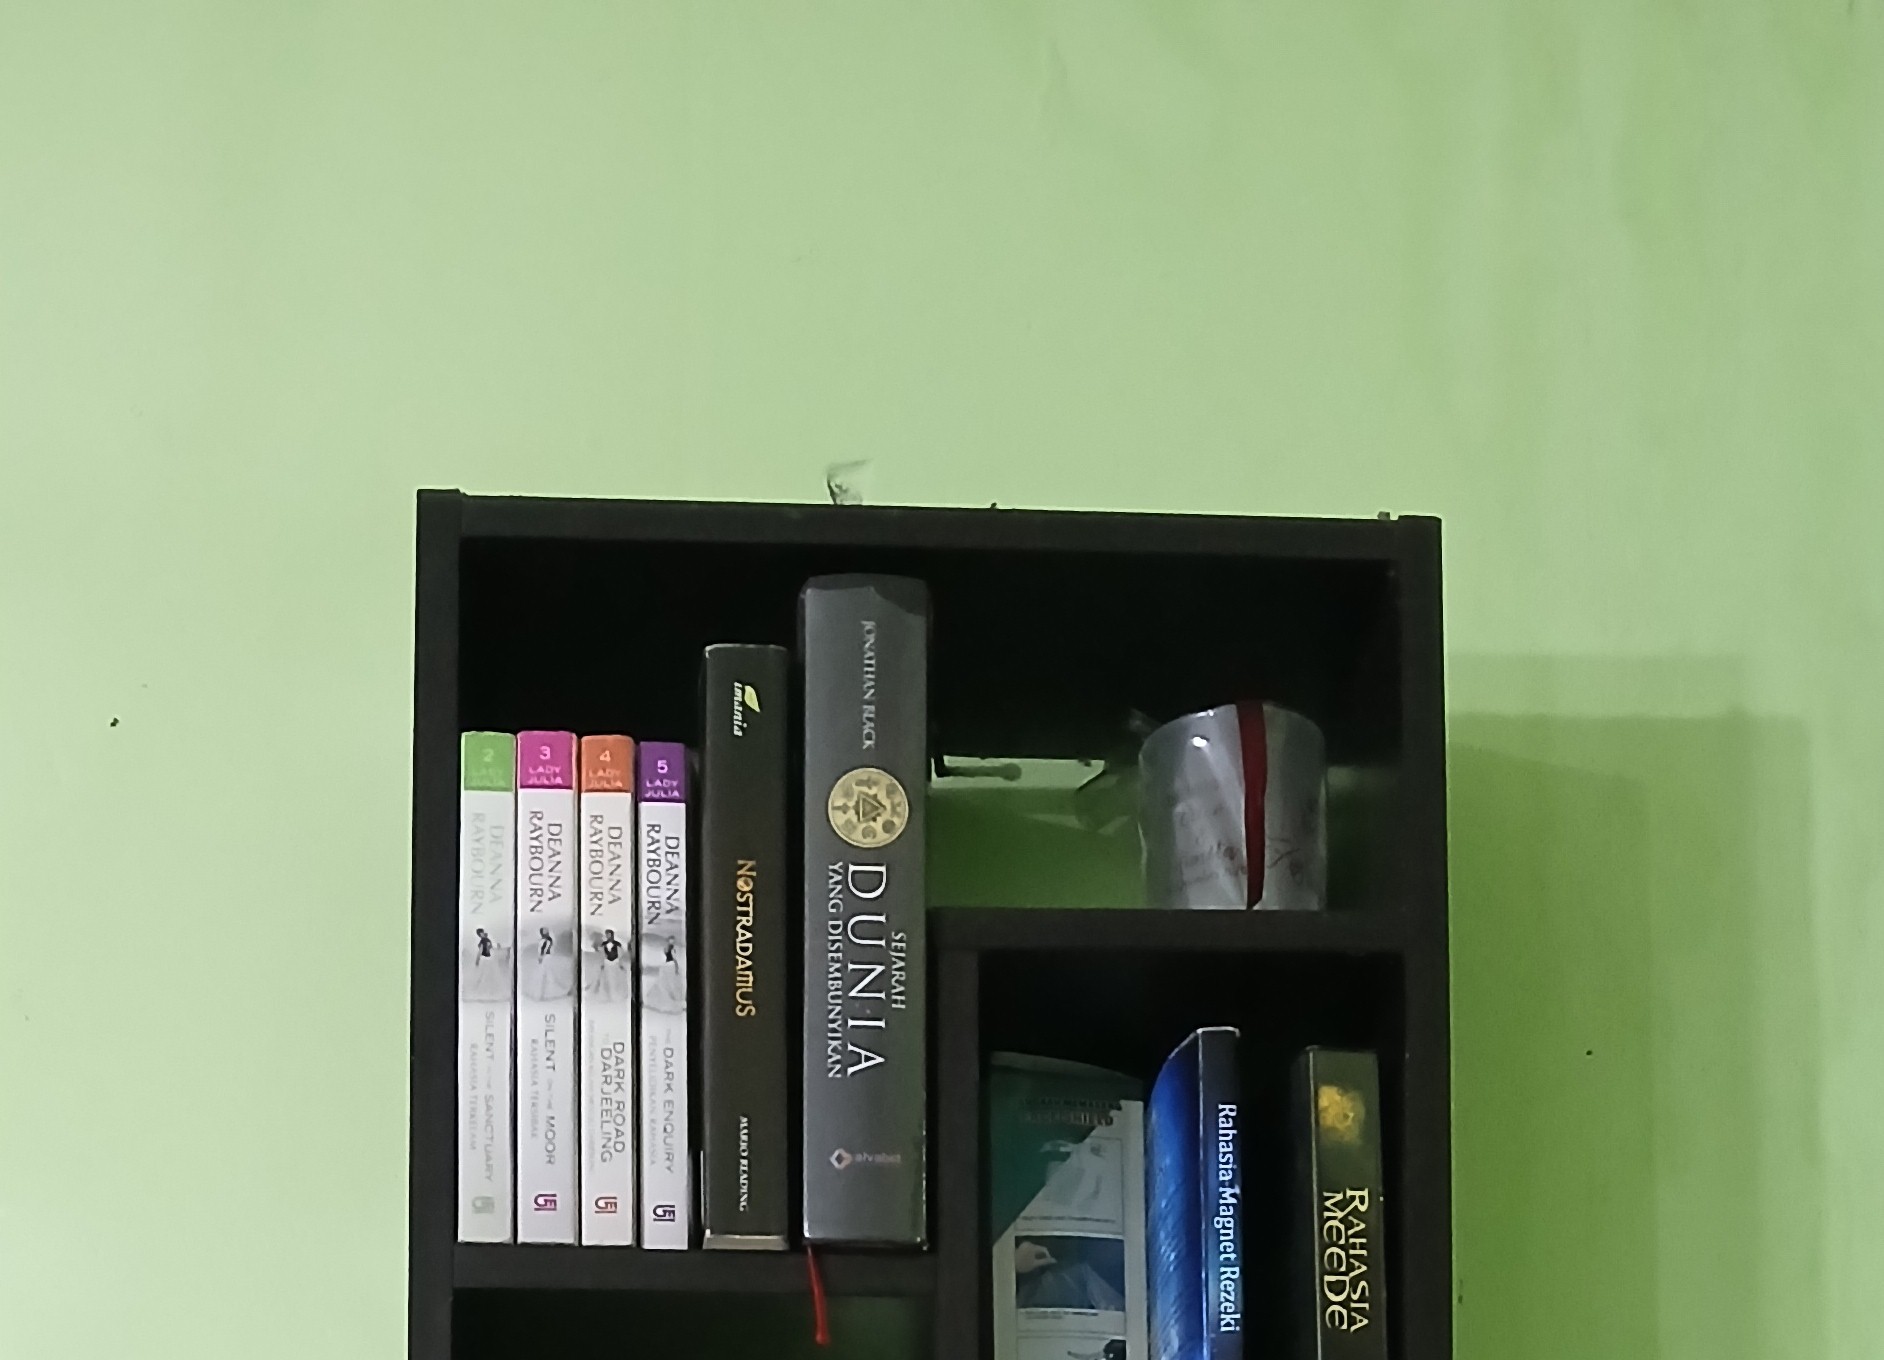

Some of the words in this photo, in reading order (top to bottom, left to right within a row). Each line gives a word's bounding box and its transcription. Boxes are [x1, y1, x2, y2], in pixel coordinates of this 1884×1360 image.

[861, 620, 876, 700] JONATHAN
[483, 749, 494, 762] 2
[539, 746, 551, 760] 3
[600, 750, 611, 762] 4
[862, 704, 876, 750] BLACK
[528, 776, 563, 785] JULIA
[529, 765, 561, 774] LADY
[645, 790, 680, 798] JULIA
[646, 780, 678, 788] LADY
[657, 760, 668, 773] 5
[471, 812, 486, 915] RAYBOURN
[489, 825, 504, 903] DEANNA
[529, 810, 544, 912] RAYBOURN
[547, 823, 562, 901] DEANNA
[589, 815, 604, 916] RAYBOURN
[608, 826, 622, 905] DEANNA
[646, 824, 662, 925] RAYBOURN
[665, 836, 680, 914] DEANNA
[828, 861, 843, 912] YANG
[736, 859, 756, 1018] NOSTRADAMUS
[847, 863, 887, 1078] DUNIA
[891, 932, 906, 1010] SEJARAH
[827, 920, 843, 1078] DISEMBUNYIKAN
[485, 1011, 495, 1060] SILENT
[545, 1014, 555, 1071] SILENT
[613, 1042, 625, 1092] DARK
[663, 1048, 674, 1093] DARK
[484, 1094, 494, 1182] SANCTUARY
[545, 1115, 555, 1165] MOOR
[601, 1048, 612, 1163] DARJEELING
[613, 1101, 626, 1153] ROAD
[663, 1102, 674, 1173] ENQUIRY
[1218, 1104, 1238, 1181] Rahasia
[1214, 1187, 1238, 1261] Magnet
[1341, 1187, 1369, 1333] RAHASIA
[1219, 1266, 1241, 1332] Rezeki
